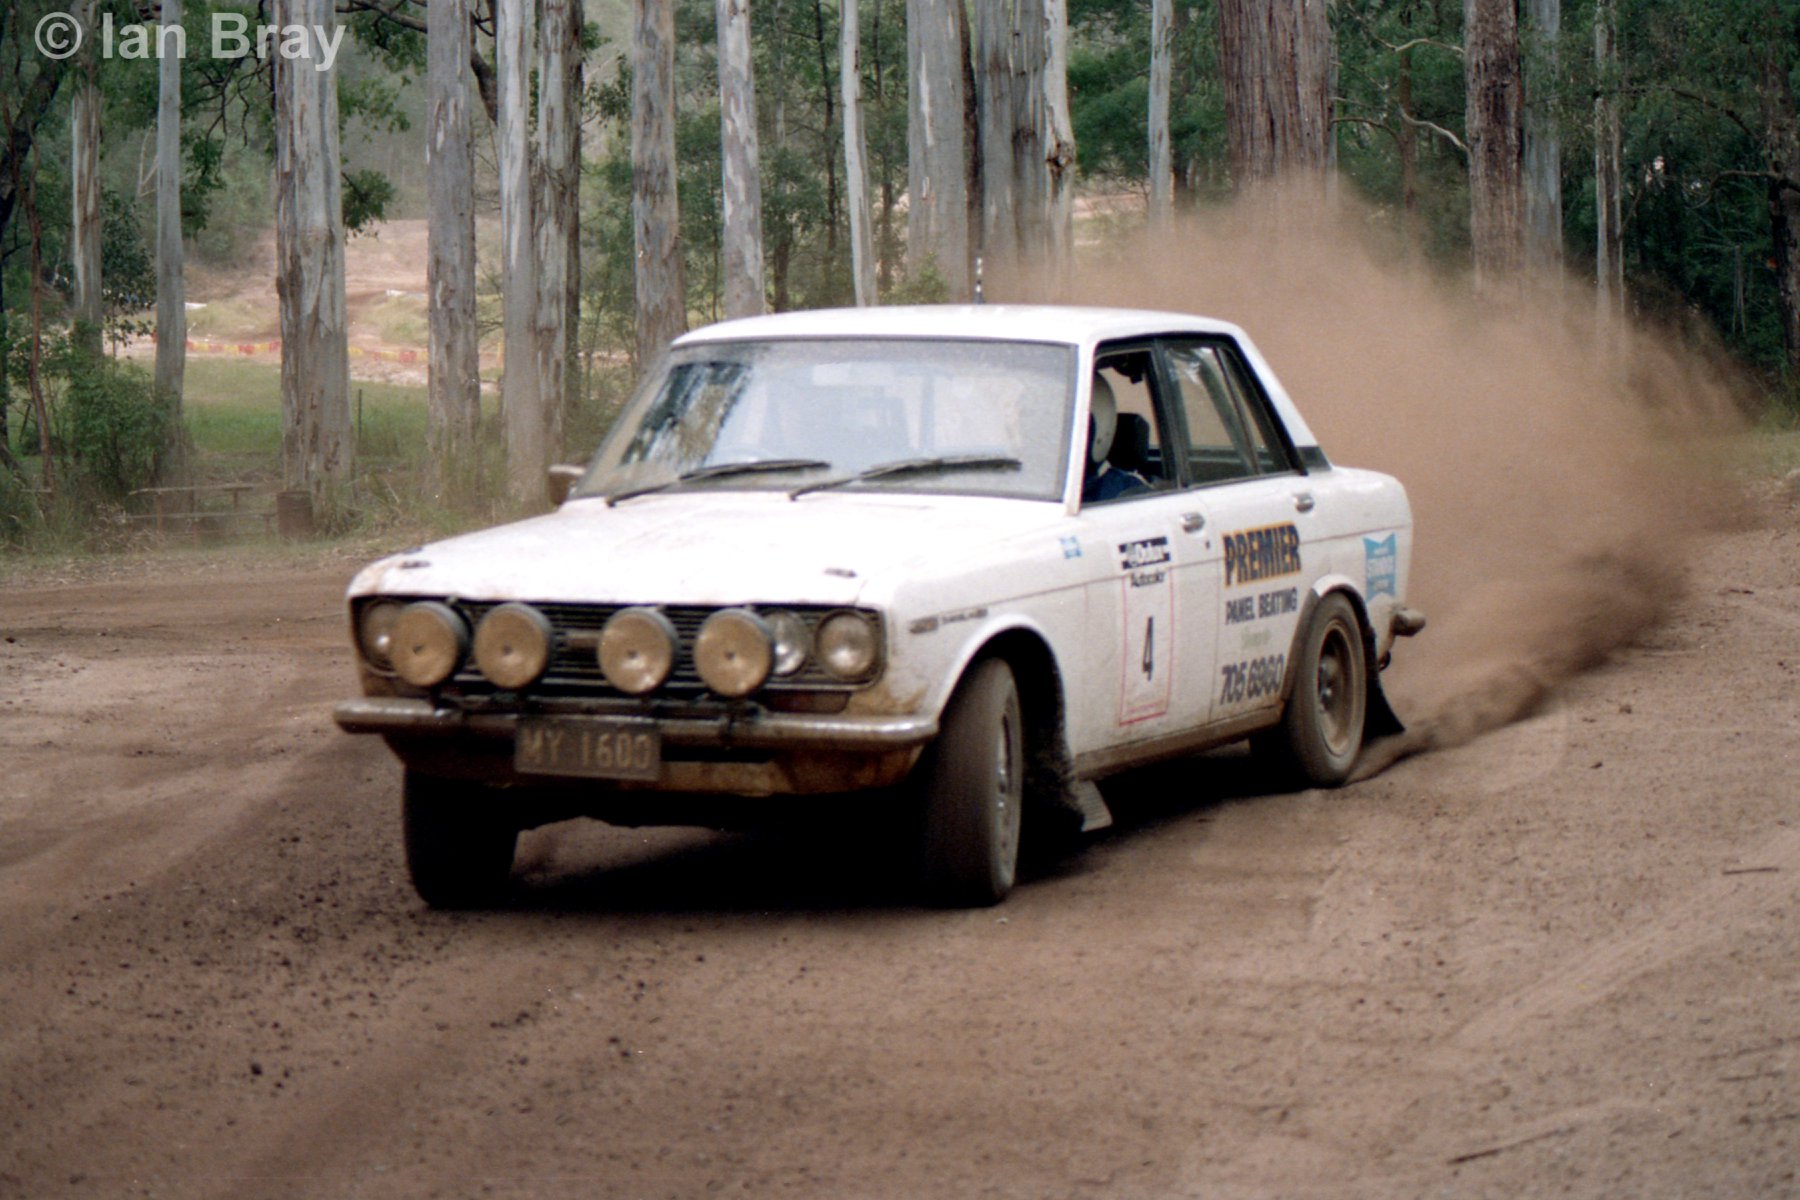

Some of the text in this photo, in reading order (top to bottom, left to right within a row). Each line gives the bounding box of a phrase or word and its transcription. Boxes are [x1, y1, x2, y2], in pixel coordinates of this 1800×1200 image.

[1222, 522, 1301, 588] PREMIER
[1225, 586, 1298, 625] PANEL BEATING
[1142, 615, 1154, 682] 4
